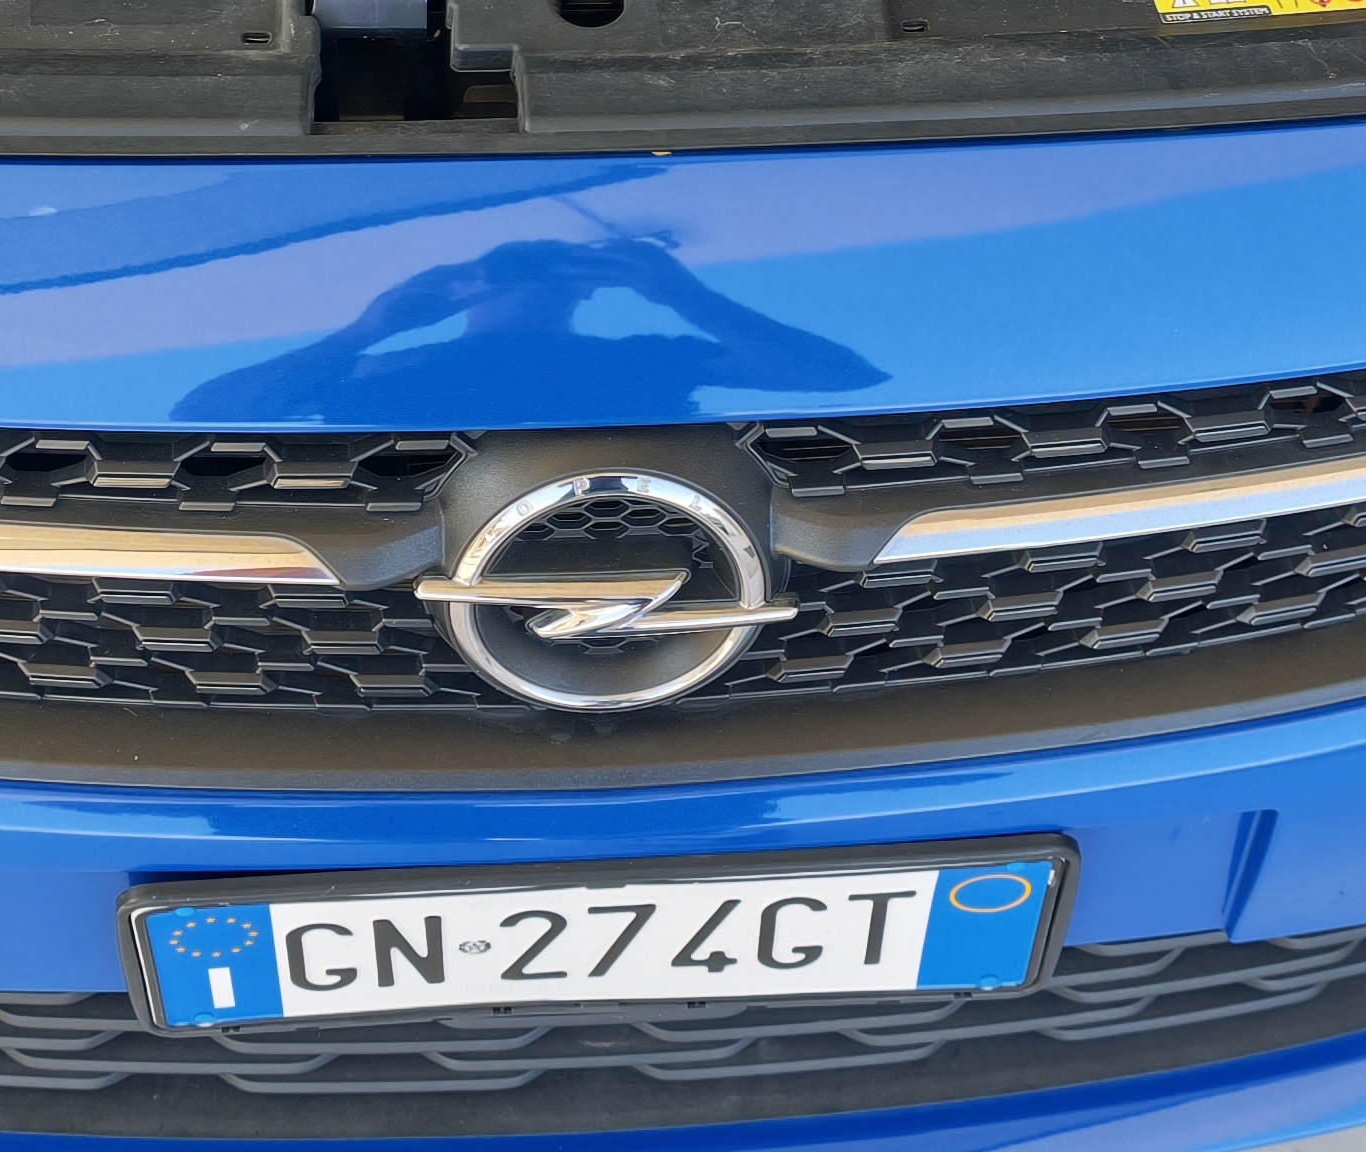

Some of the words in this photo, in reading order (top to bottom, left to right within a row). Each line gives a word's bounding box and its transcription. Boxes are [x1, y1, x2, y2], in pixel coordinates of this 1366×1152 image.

[1165, 13, 1191, 22] STOP
[1199, 9, 1232, 20] START
[1233, 7, 1270, 18] SYSTEM
[515, 477, 704, 517] OPEL
[285, 915, 446, 991] GN
[499, 890, 917, 981] 274GT
